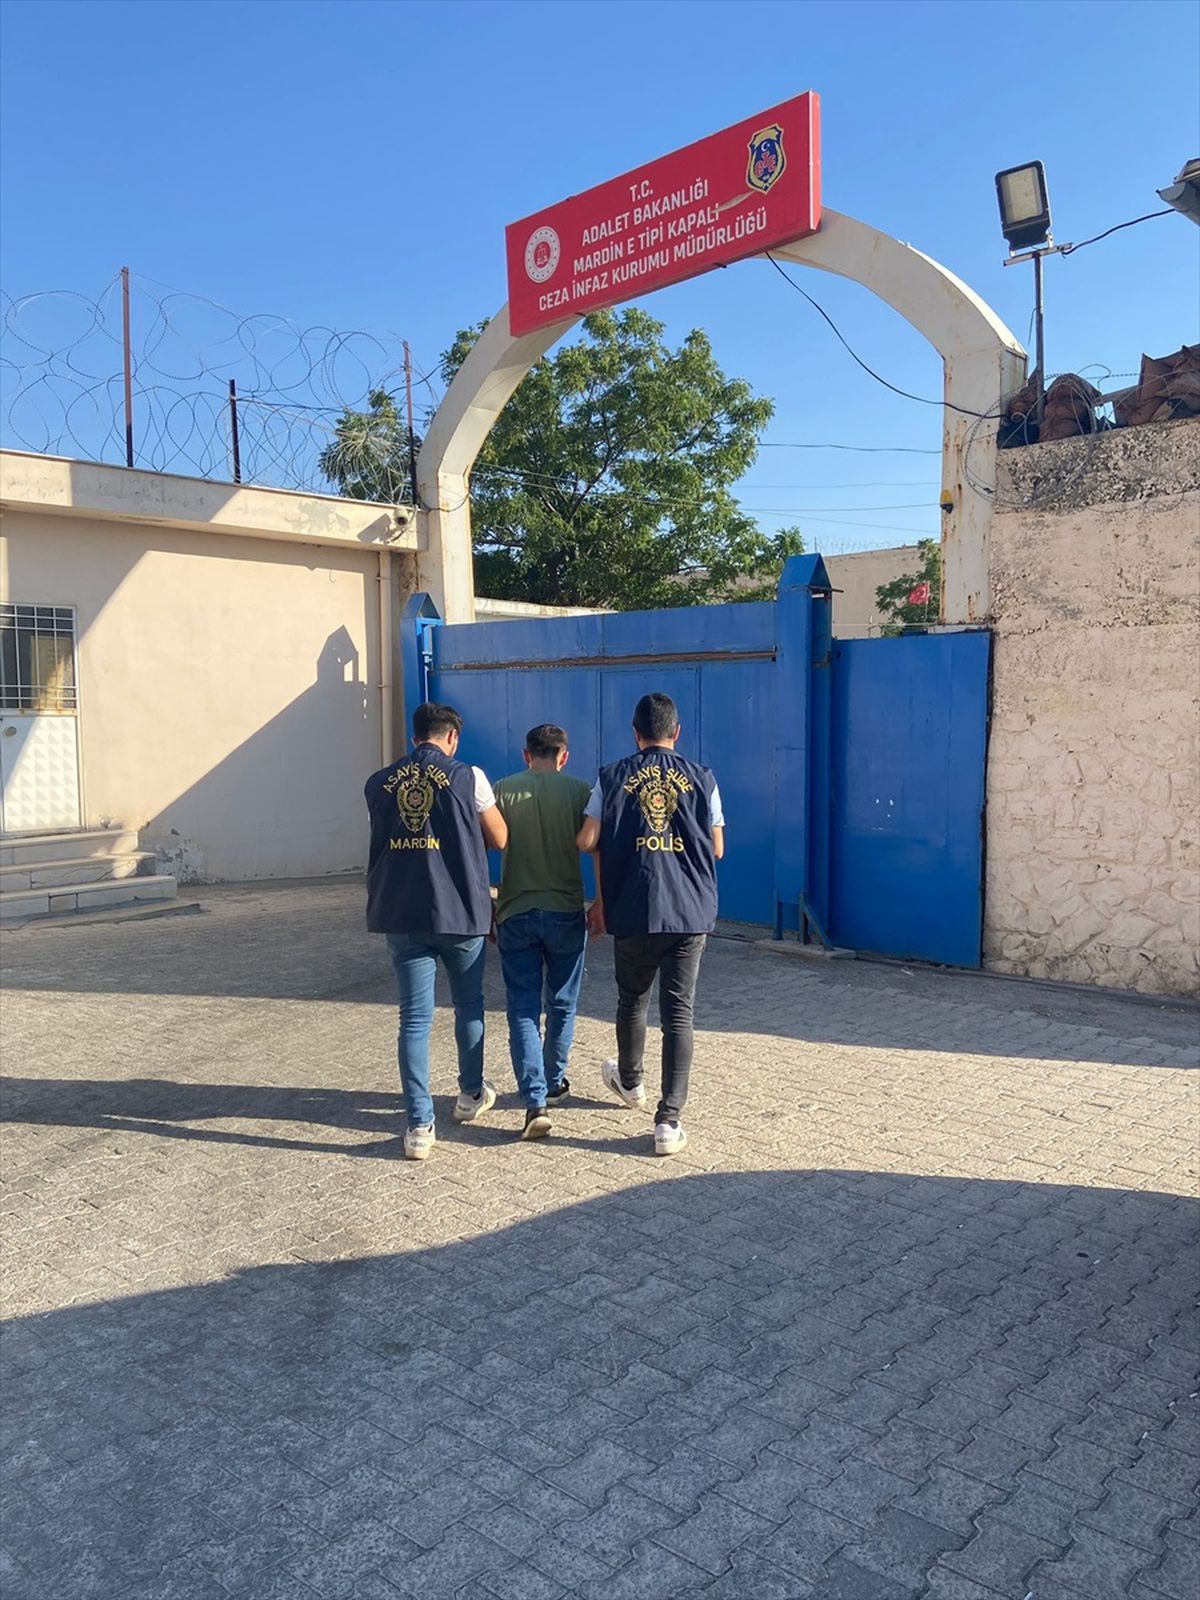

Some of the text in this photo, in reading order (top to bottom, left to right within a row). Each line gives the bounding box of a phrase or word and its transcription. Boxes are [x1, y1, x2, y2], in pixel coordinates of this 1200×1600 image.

[629, 180, 653, 202] T.C.
[582, 178, 708, 246] ADALET BAKANLIĞI
[539, 207, 767, 311] CEZA İNFAZ KURUMU MÜDÜRLÜĞÜ
[574, 241, 623, 275] MARDİN
[627, 238, 635, 255] E
[638, 222, 663, 250] TİPİ
[425, 764, 450, 790] ŞUBE
[666, 767, 693, 793] ŞUBE
[389, 834, 440, 850] MARDİN
[636, 833, 684, 852] POLİS
